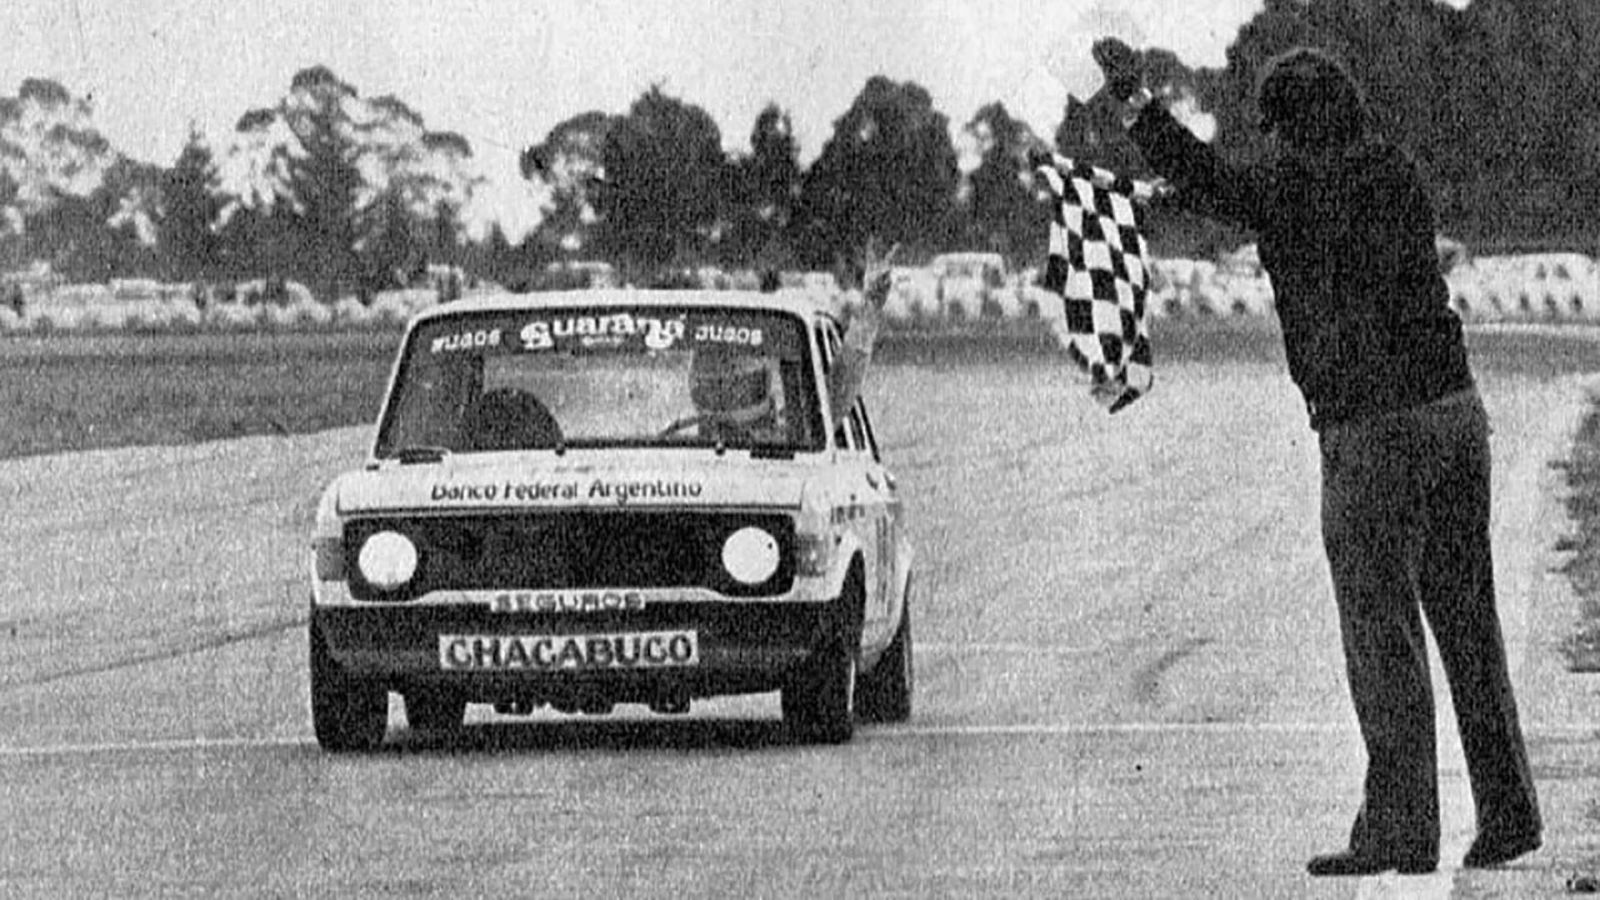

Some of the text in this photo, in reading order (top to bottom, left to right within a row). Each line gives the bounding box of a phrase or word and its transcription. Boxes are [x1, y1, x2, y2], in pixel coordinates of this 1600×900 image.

[431, 479, 703, 507] Banco Federal Argentino
[494, 592, 643, 611] SEGUROS
[447, 634, 692, 667] CHACABUCO
